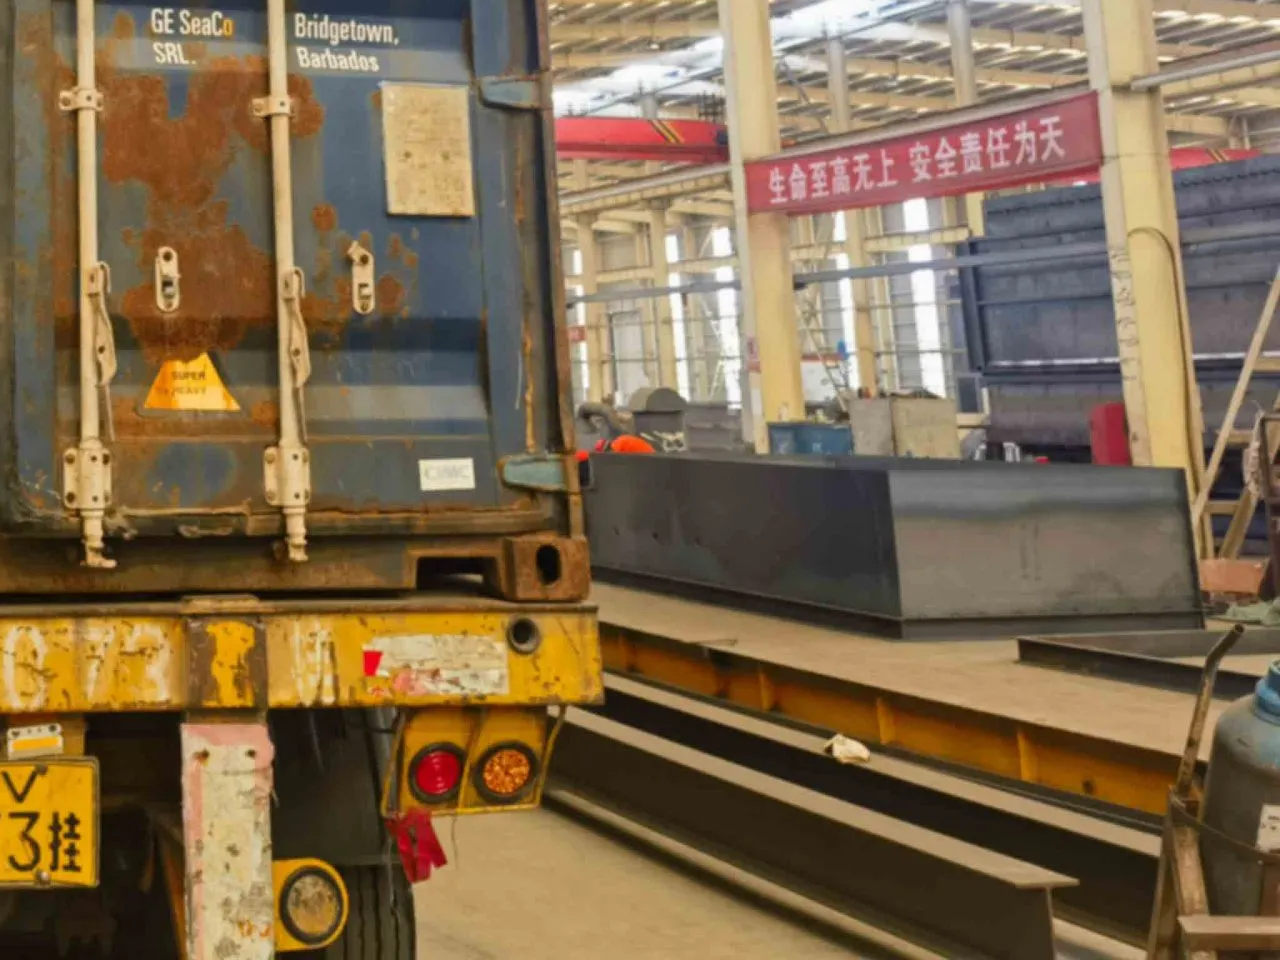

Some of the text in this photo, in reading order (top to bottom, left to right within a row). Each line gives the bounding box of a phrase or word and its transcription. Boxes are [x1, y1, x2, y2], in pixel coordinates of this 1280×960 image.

[150, 7, 400, 46] GE SeaCo Bridgetown,
[152, 42, 379, 72] SRL. Barbados
[768, 115, 1065, 204] 生命至高无上 安全责任为天
[1, 770, 39, 803] V
